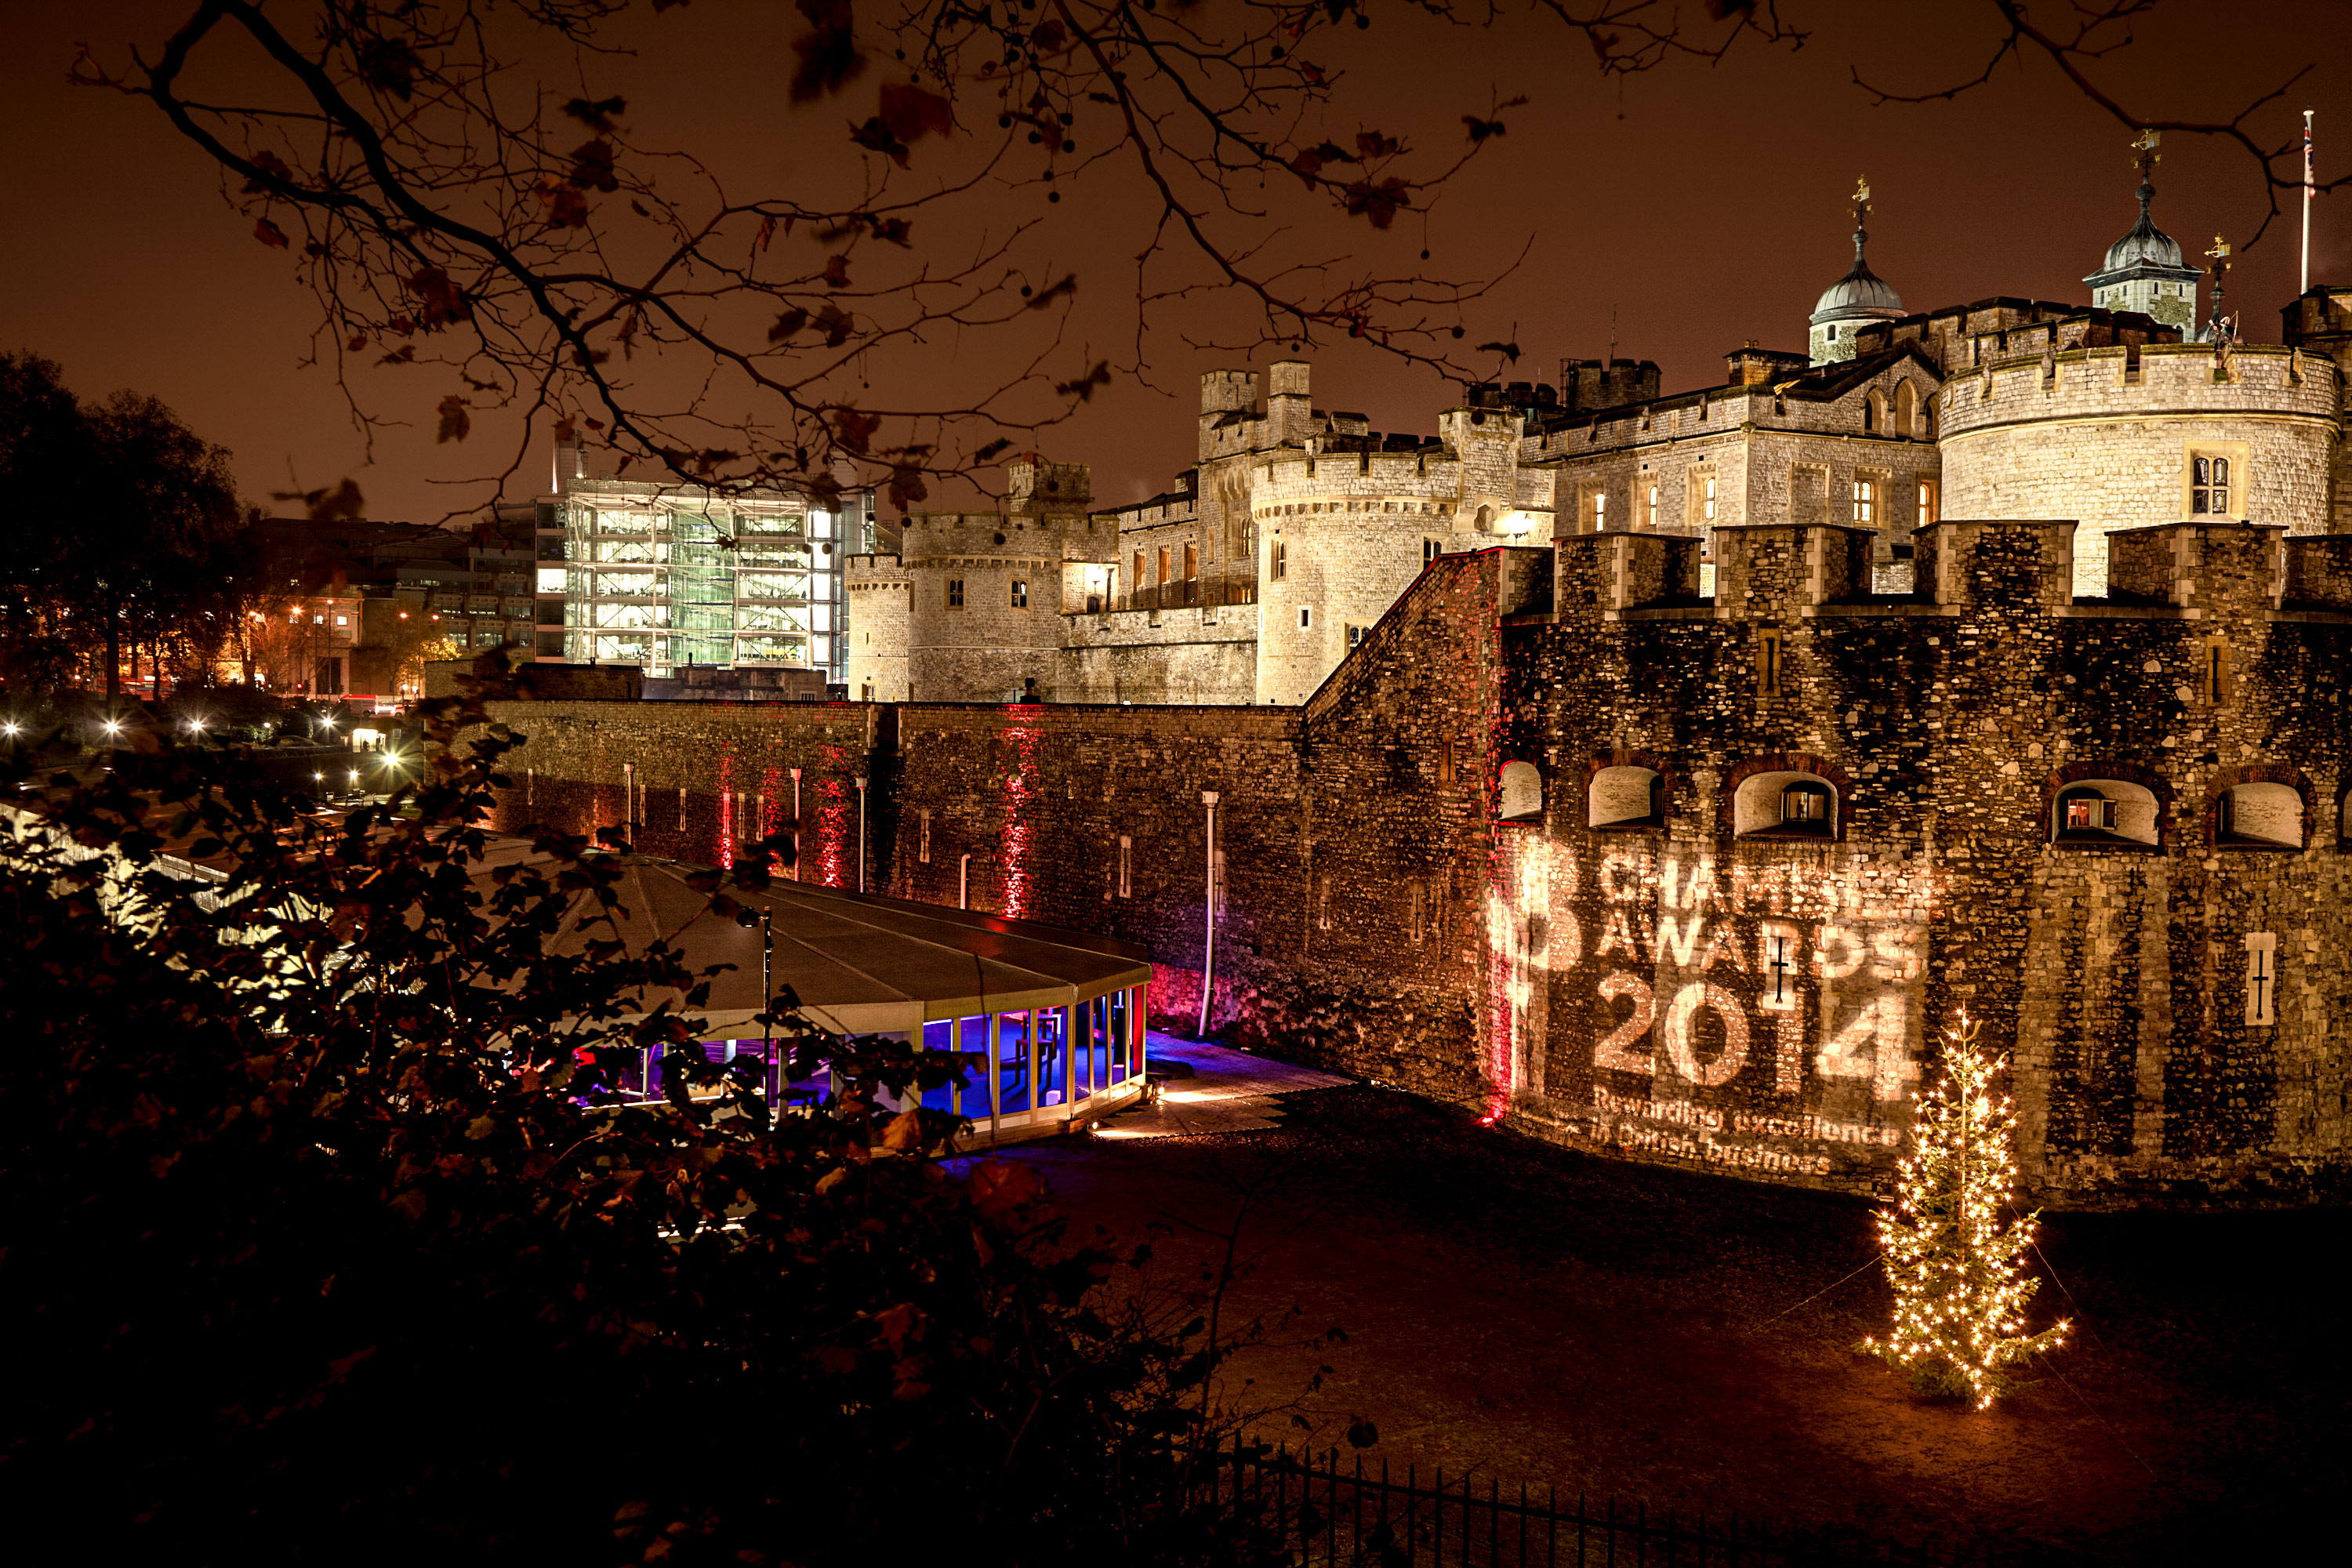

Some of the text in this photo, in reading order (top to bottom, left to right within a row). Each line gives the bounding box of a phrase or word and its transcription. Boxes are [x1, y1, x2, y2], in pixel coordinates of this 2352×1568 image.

[1596, 910, 1921, 980] AWARDS
[1592, 971, 1922, 1102] 2014
[1593, 1085, 1902, 1146] Rewarding excellence
